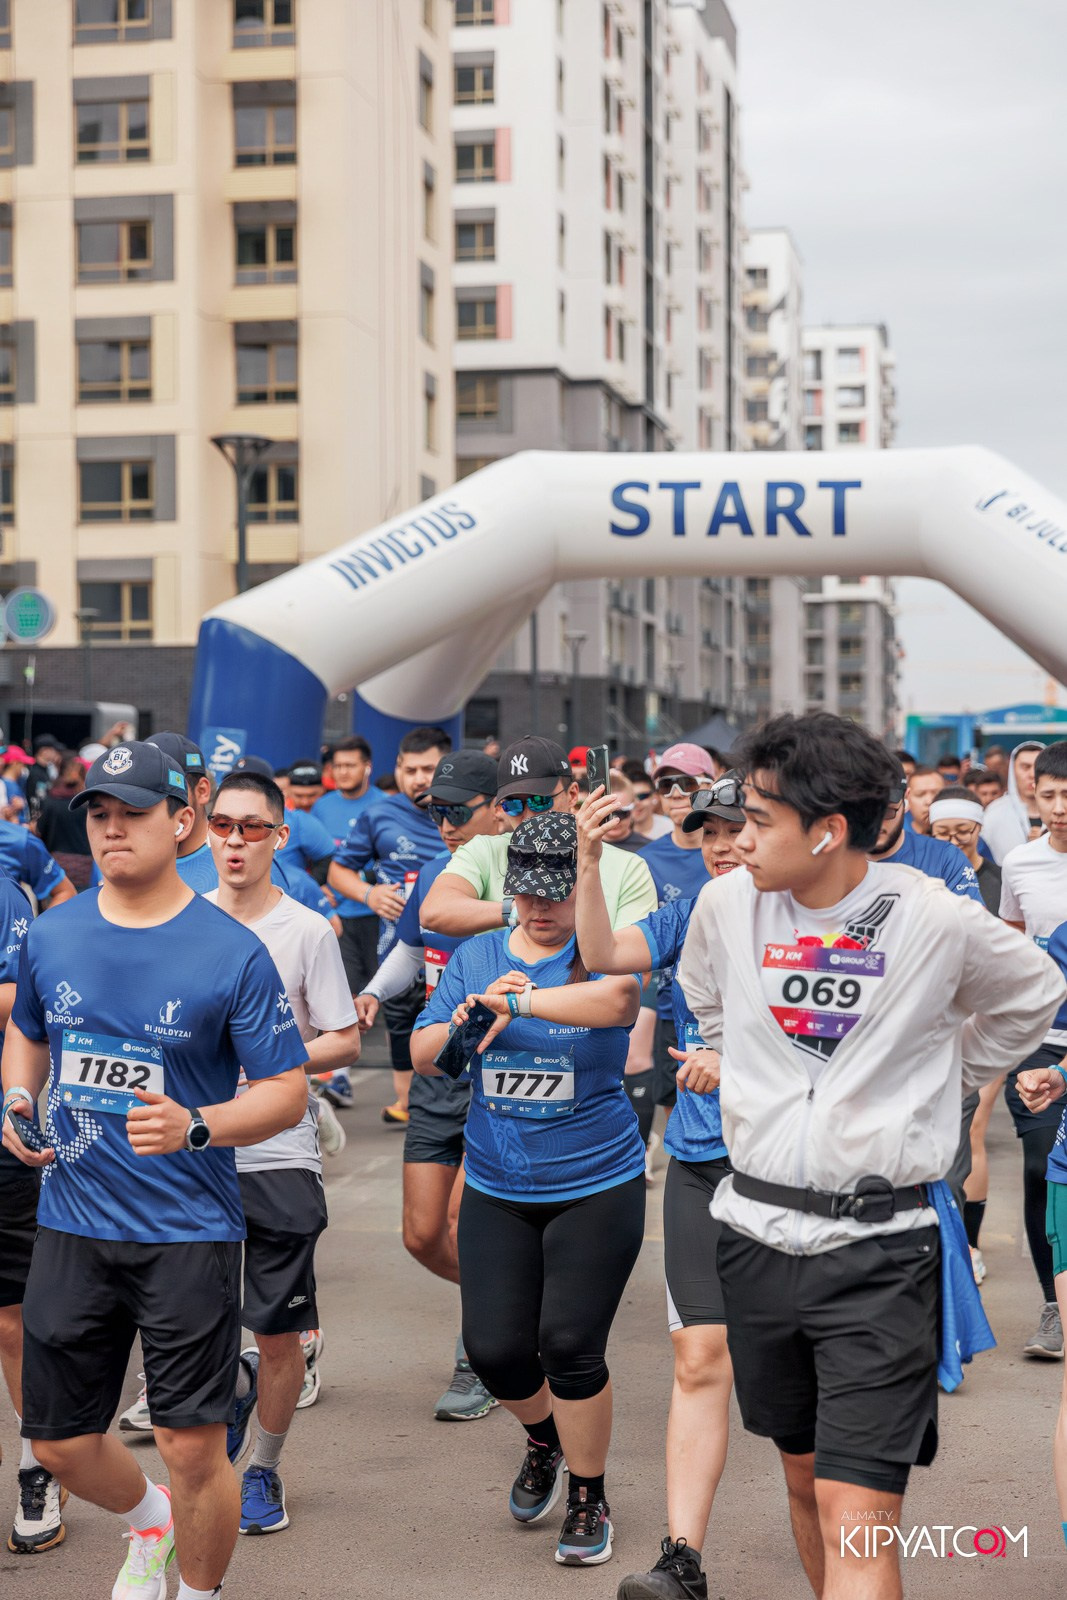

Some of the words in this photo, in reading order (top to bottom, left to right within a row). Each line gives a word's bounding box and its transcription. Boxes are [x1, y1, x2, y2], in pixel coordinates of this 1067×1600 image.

[609, 481, 862, 537] START
[329, 502, 477, 590] INVICTUS
[770, 948, 784, 960] 10
[785, 951, 803, 961] KM
[840, 956, 866, 966] GROUP
[782, 974, 862, 1009] 069
[53, 1014, 85, 1026] GROUP
[144, 1023, 153, 1032] BI
[153, 1026, 192, 1038] JULDYZAI
[67, 1033, 77, 1044] 5
[78, 1036, 93, 1046] KM
[131, 1045, 151, 1054] GROUP
[485, 1054, 494, 1062] 5
[494, 1055, 508, 1063] KM
[78, 1056, 151, 1092] 1182
[495, 1072, 564, 1098] 1777
